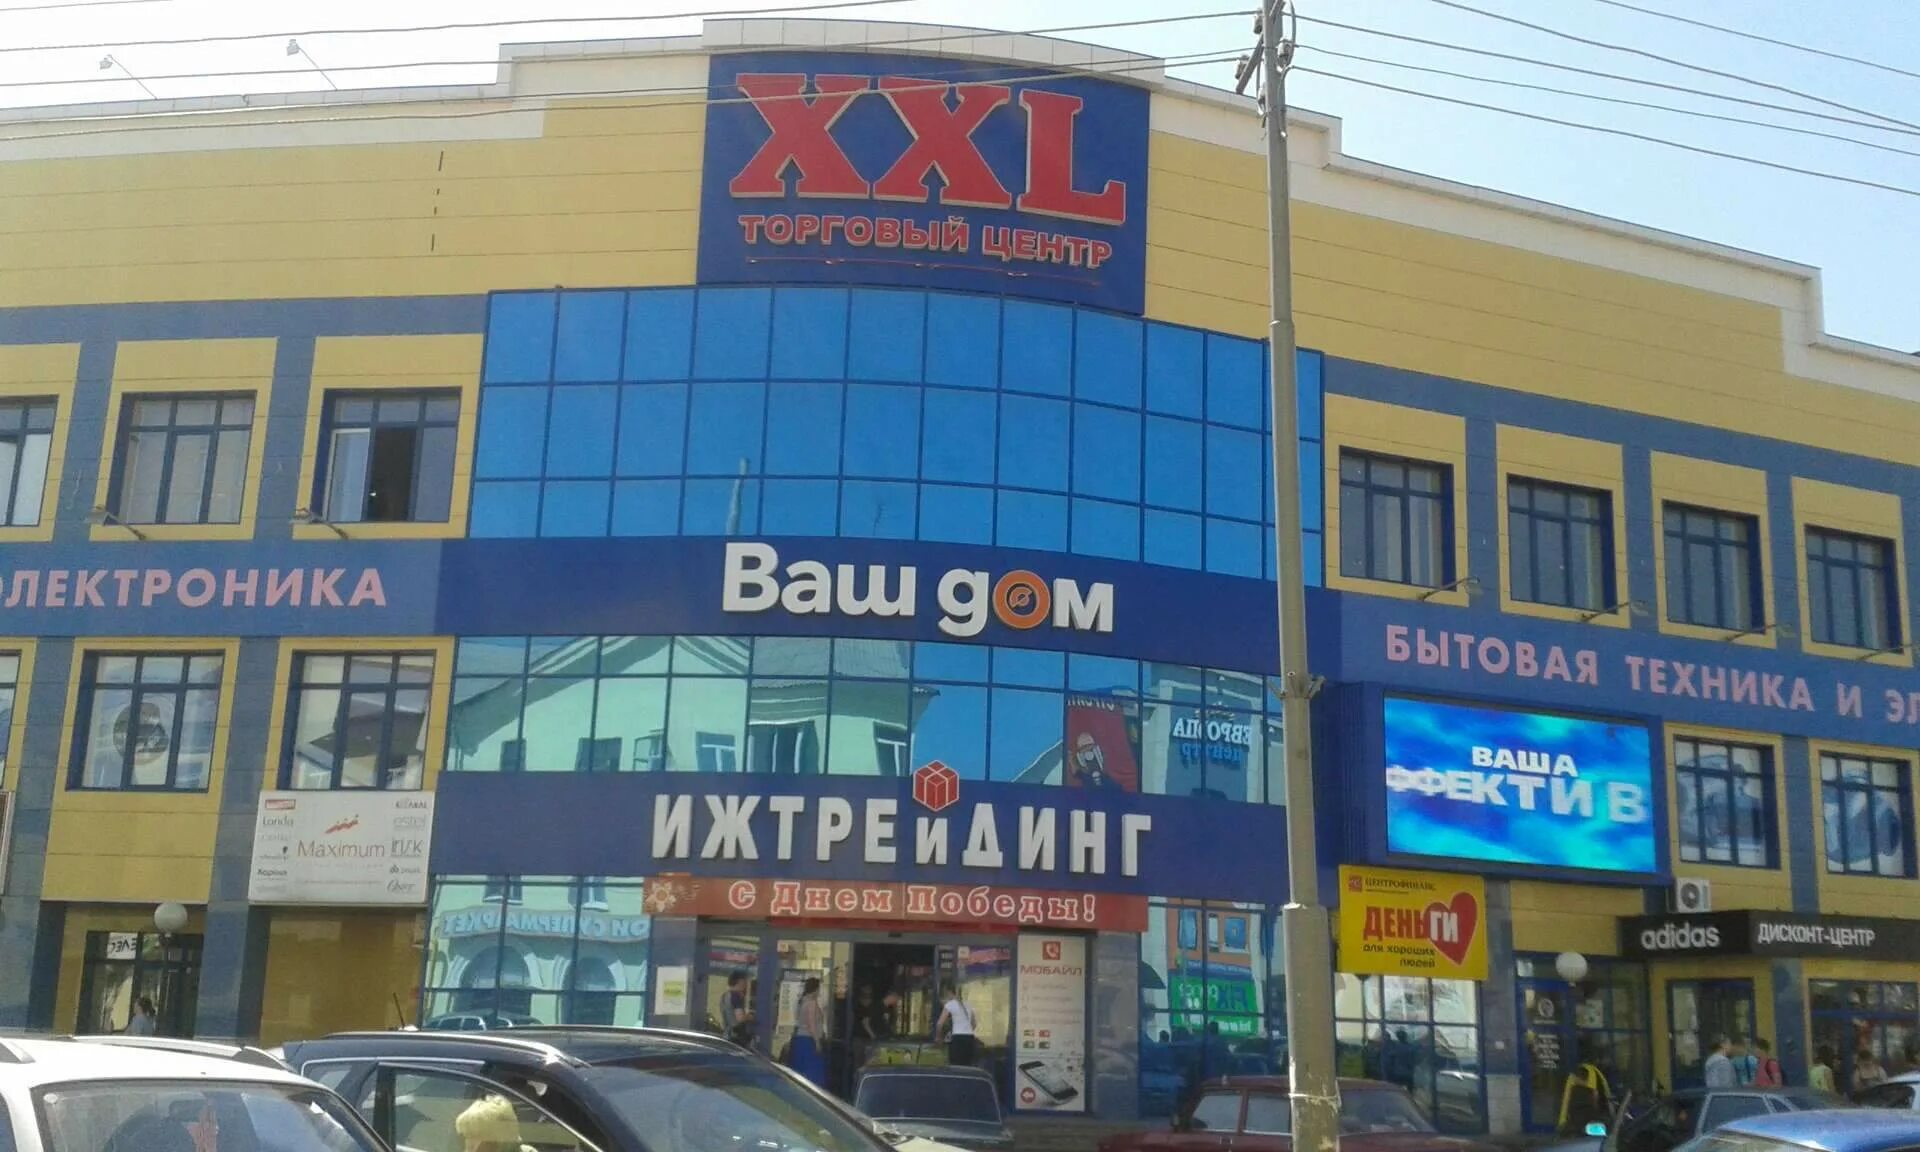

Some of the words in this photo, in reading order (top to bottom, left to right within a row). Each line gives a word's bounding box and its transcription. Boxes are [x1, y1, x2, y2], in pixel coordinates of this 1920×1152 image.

[730, 73, 1127, 225] XXL
[738, 214, 969, 253] ТОРГОВЫЙ
[982, 226, 1113, 269] ЦЕНТР
[0, 567, 387, 608] ЛЕКТРОНИКА
[723, 542, 917, 616] Ваш
[937, 568, 1114, 637] дом
[1385, 623, 1600, 686] БЫТОВАЯ
[1624, 654, 1816, 712] ТЕХНИКА
[1837, 680, 1863, 719] И
[1471, 745, 1579, 778] ВАША
[297, 839, 386, 858] Maximum
[729, 881, 756, 909] С
[771, 882, 892, 914] Днем
[907, 886, 1096, 922] Победы!
[1363, 906, 1459, 943] ДЕНЬГИ
[1641, 922, 1720, 949] adidas
[1757, 923, 1876, 948] ДИСКОНТ-ЦЕНТР
